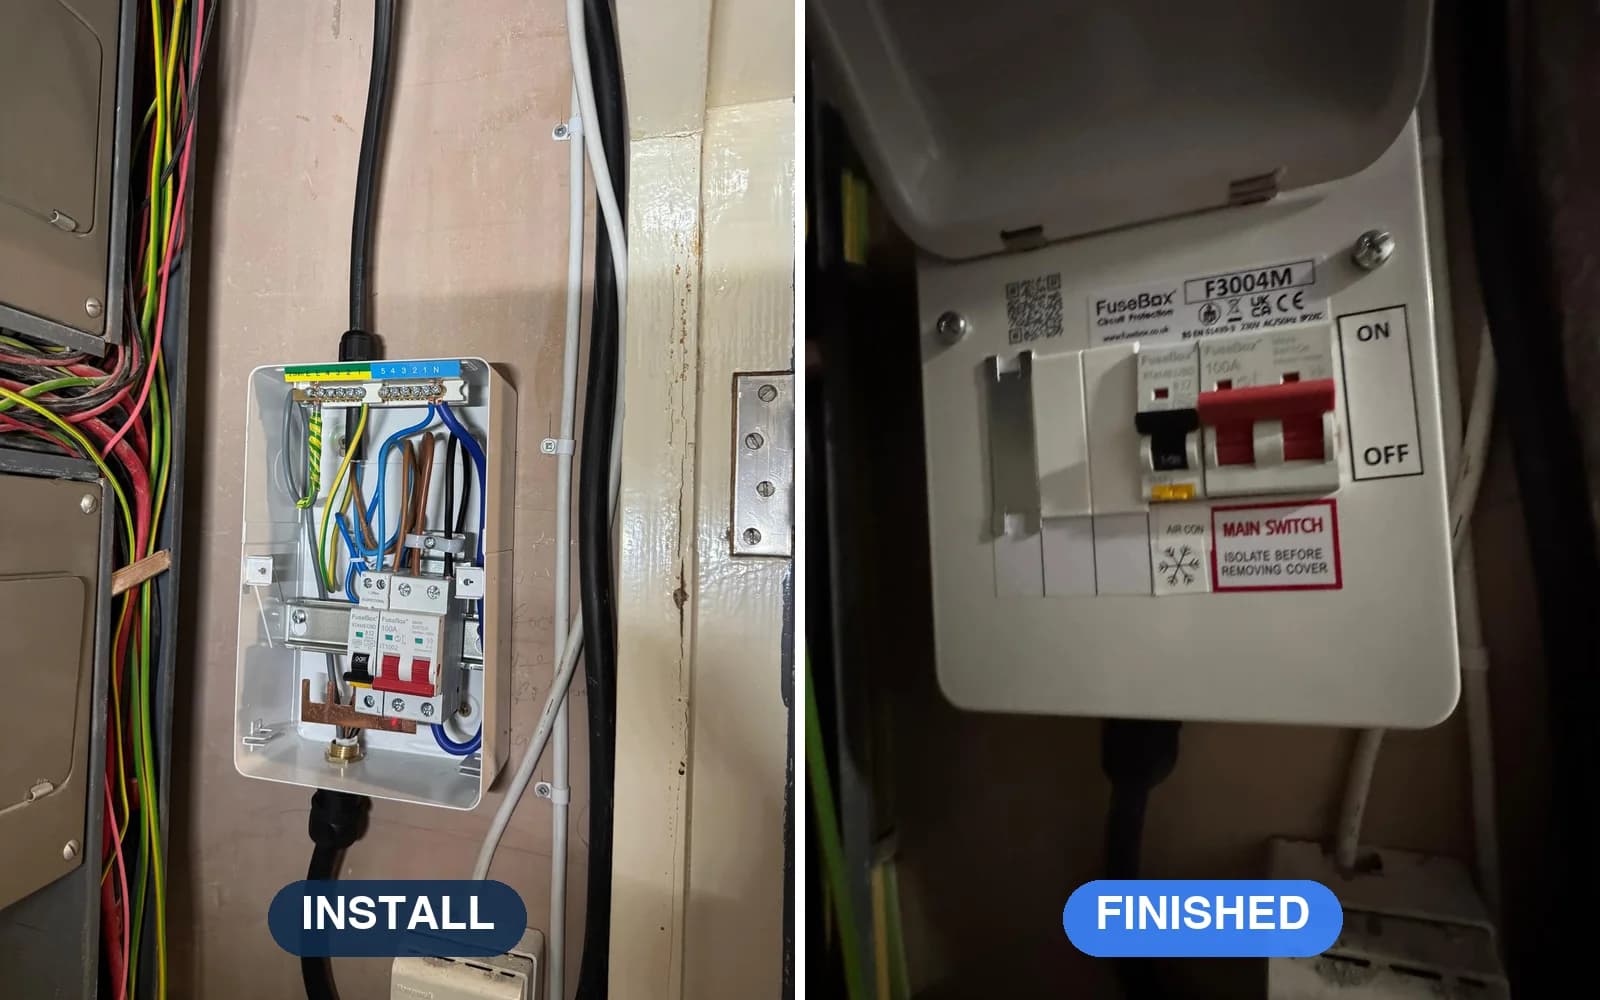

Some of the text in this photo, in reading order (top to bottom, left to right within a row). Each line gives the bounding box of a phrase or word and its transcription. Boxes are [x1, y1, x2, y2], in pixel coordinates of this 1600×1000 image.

[1206, 267, 1292, 299] F3004M
[1096, 289, 1175, 316] FuseBox
[1250, 294, 1270, 307] UK
[1128, 309, 1173, 321] Protection
[1251, 306, 1271, 318] CA
[1357, 322, 1390, 342] ON
[432, 366, 440, 374] N
[1205, 359, 1241, 374] 100A
[1364, 444, 1409, 466] OFF
[1166, 523, 1205, 534] AIR CON
[1223, 517, 1323, 537] MAIN SWITCH
[1224, 548, 1323, 563] ISOLATE BEFORE
[1221, 563, 1328, 577] REMOVING COVER
